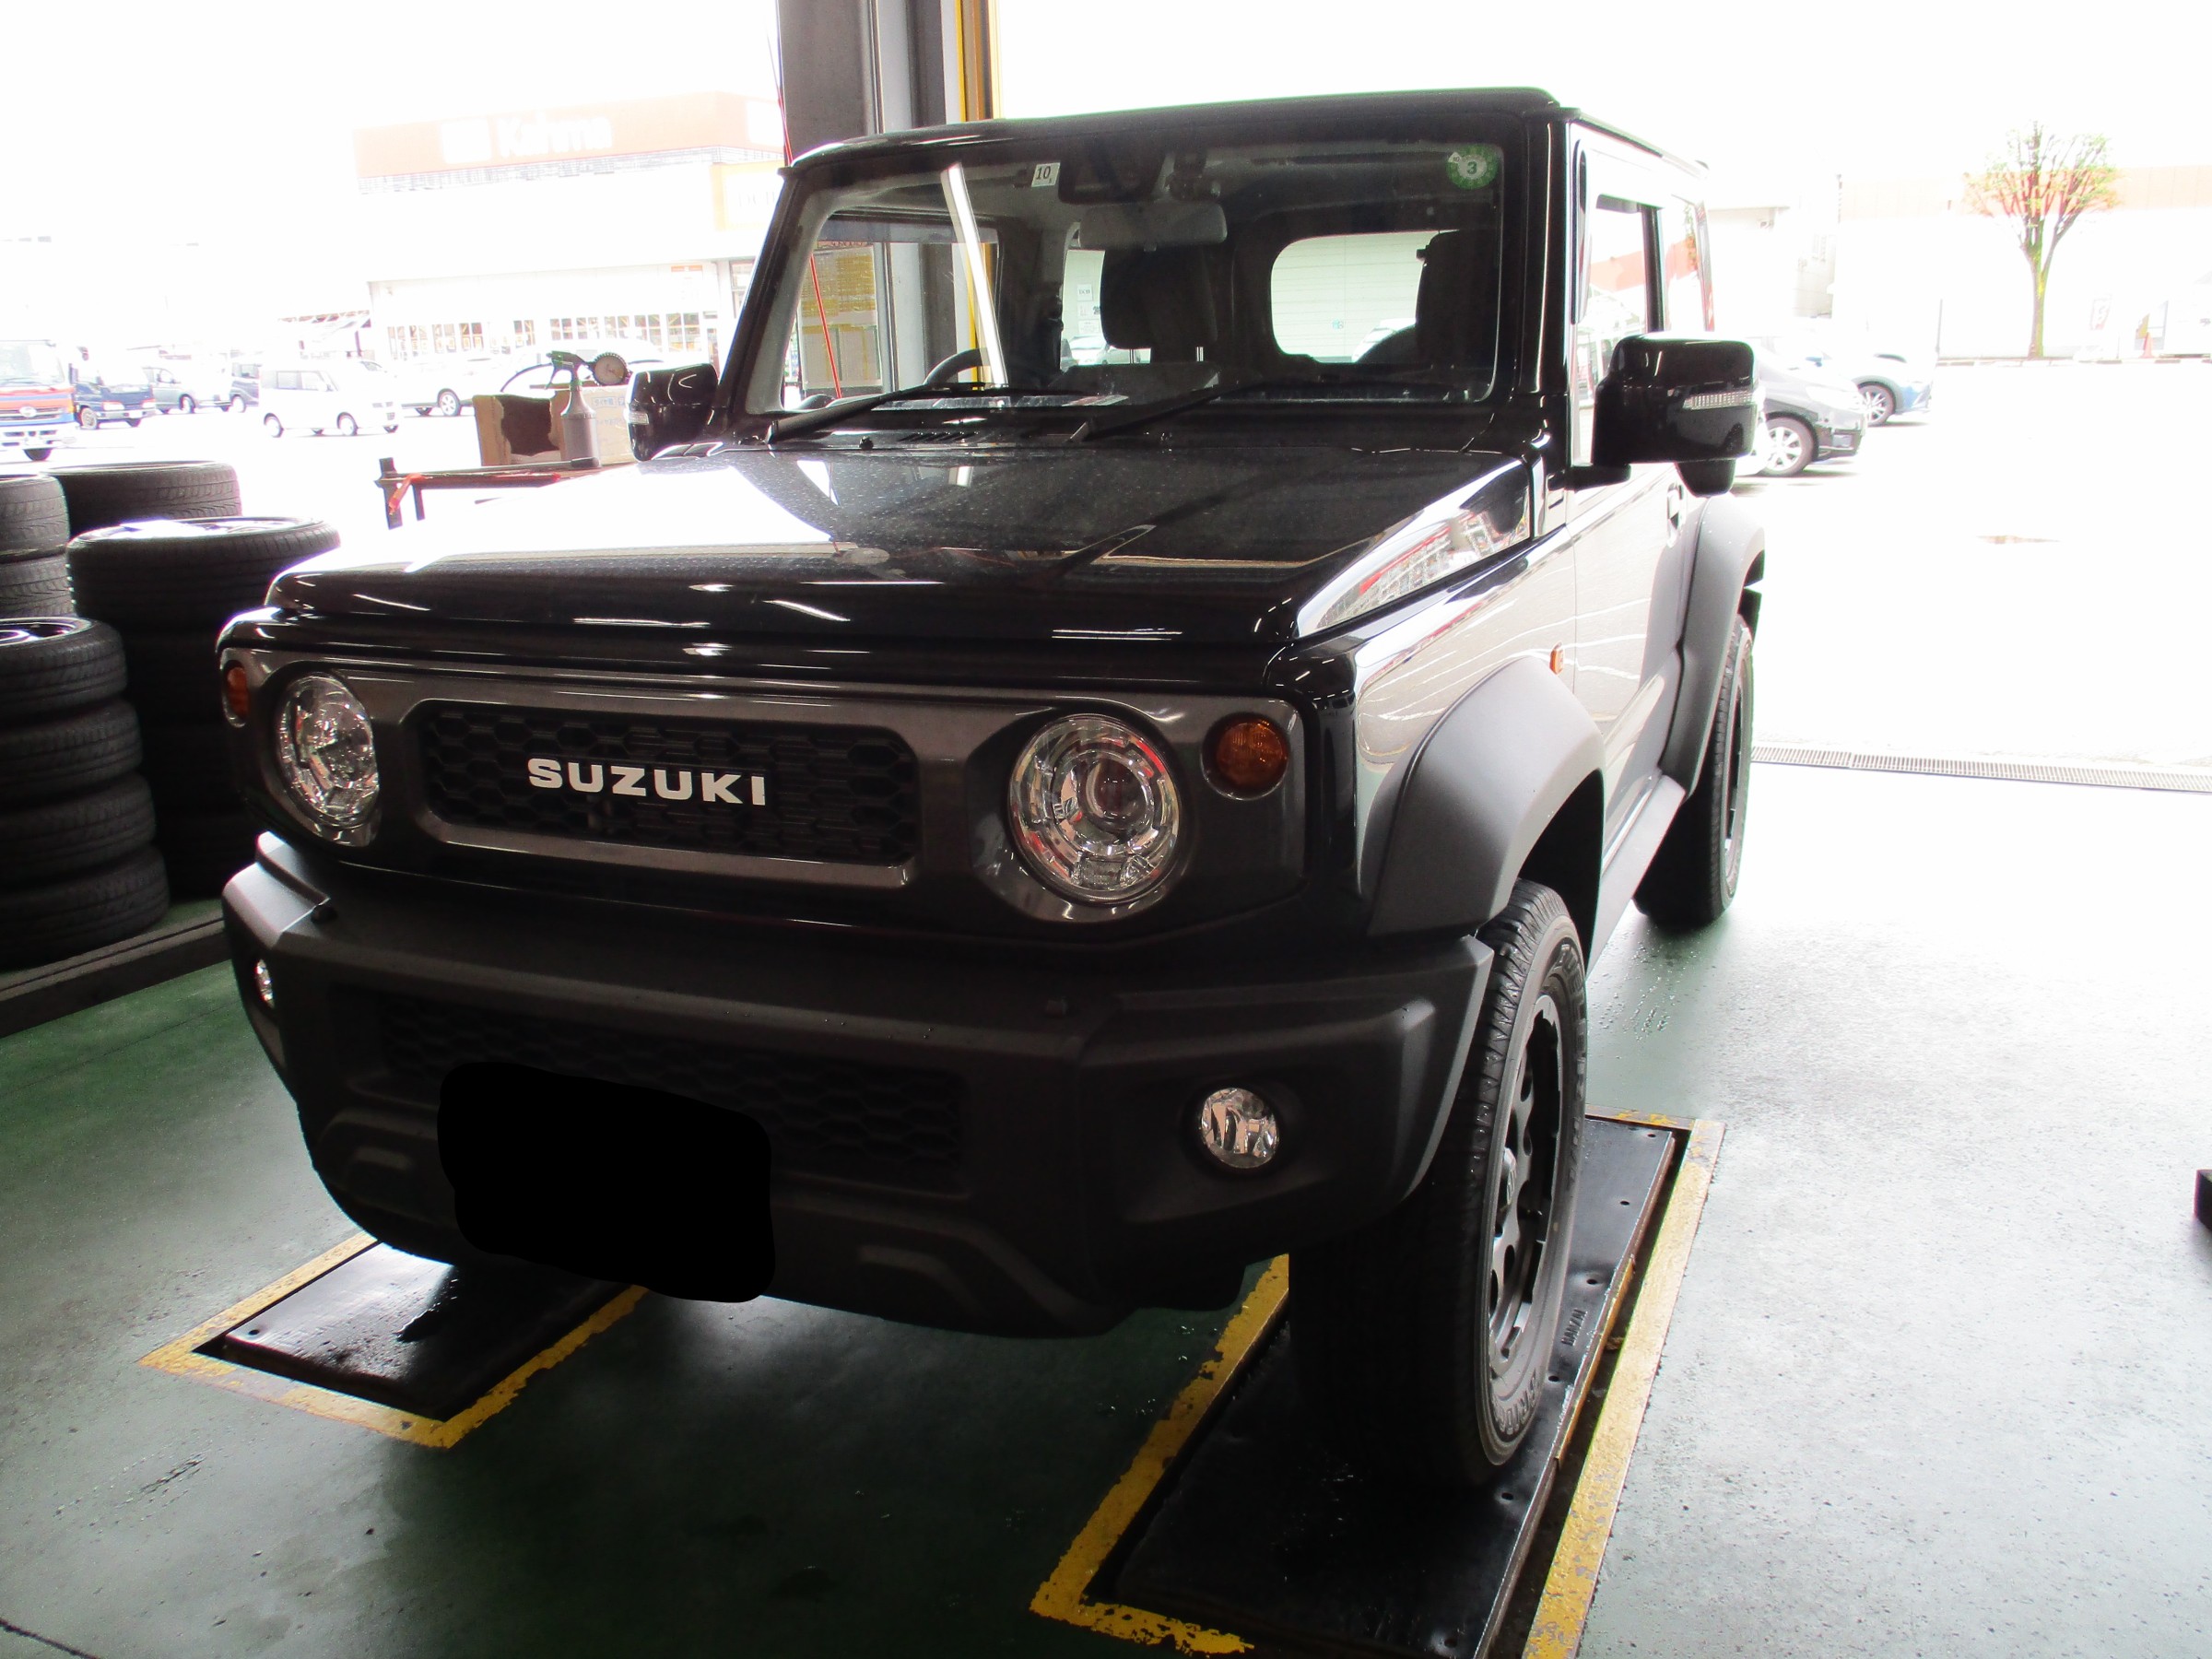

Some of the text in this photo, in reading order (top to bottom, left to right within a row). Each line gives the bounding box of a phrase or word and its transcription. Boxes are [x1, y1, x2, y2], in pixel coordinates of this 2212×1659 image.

[1035, 165, 1052, 181] 10
[1466, 160, 1477, 175] 3
[527, 757, 766, 806] SUZUKI
